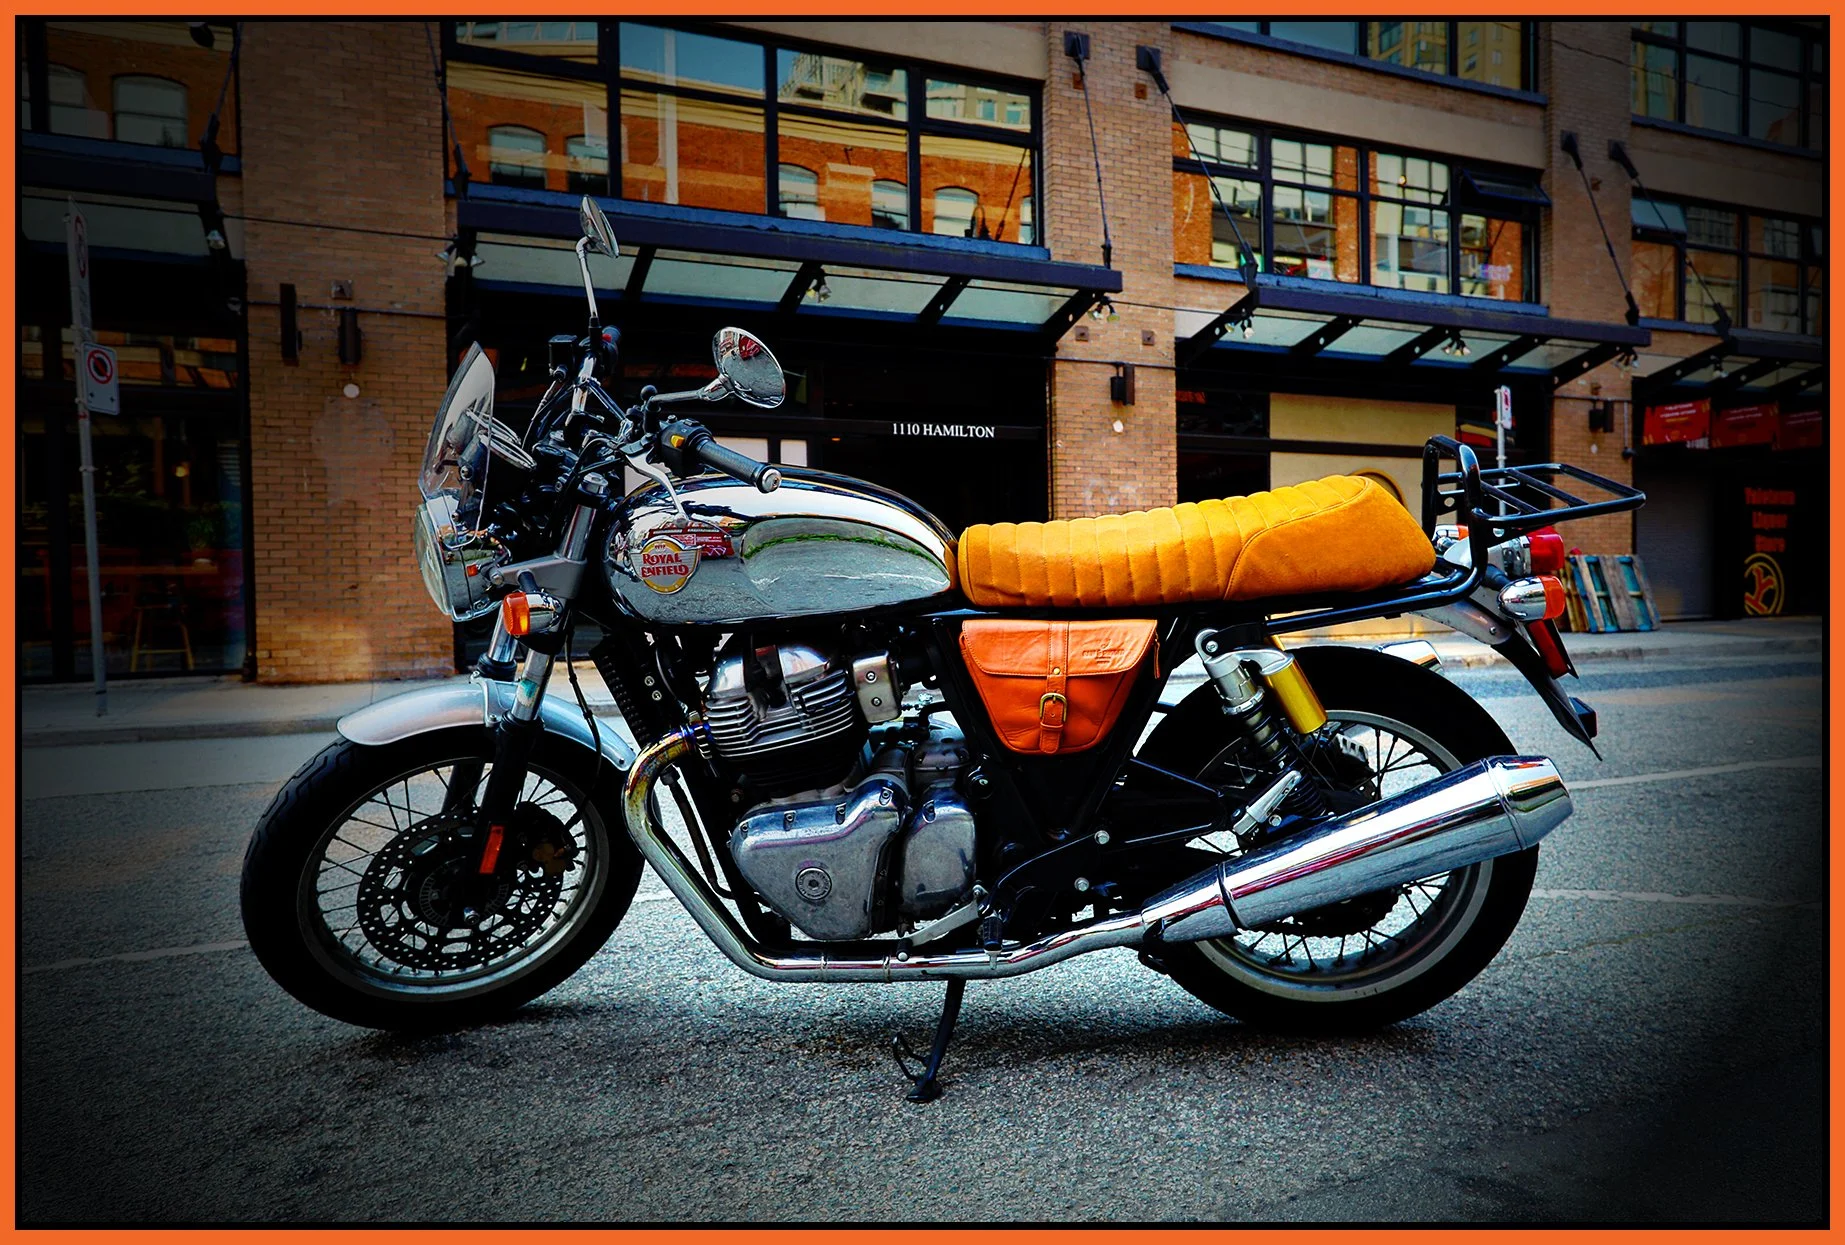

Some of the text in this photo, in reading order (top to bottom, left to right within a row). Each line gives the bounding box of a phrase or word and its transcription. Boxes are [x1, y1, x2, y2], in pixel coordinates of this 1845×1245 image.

[893, 423, 995, 438] 1110 HAMILTON
[642, 553, 682, 565] ROYAL
[641, 564, 689, 577] ENFIELD
